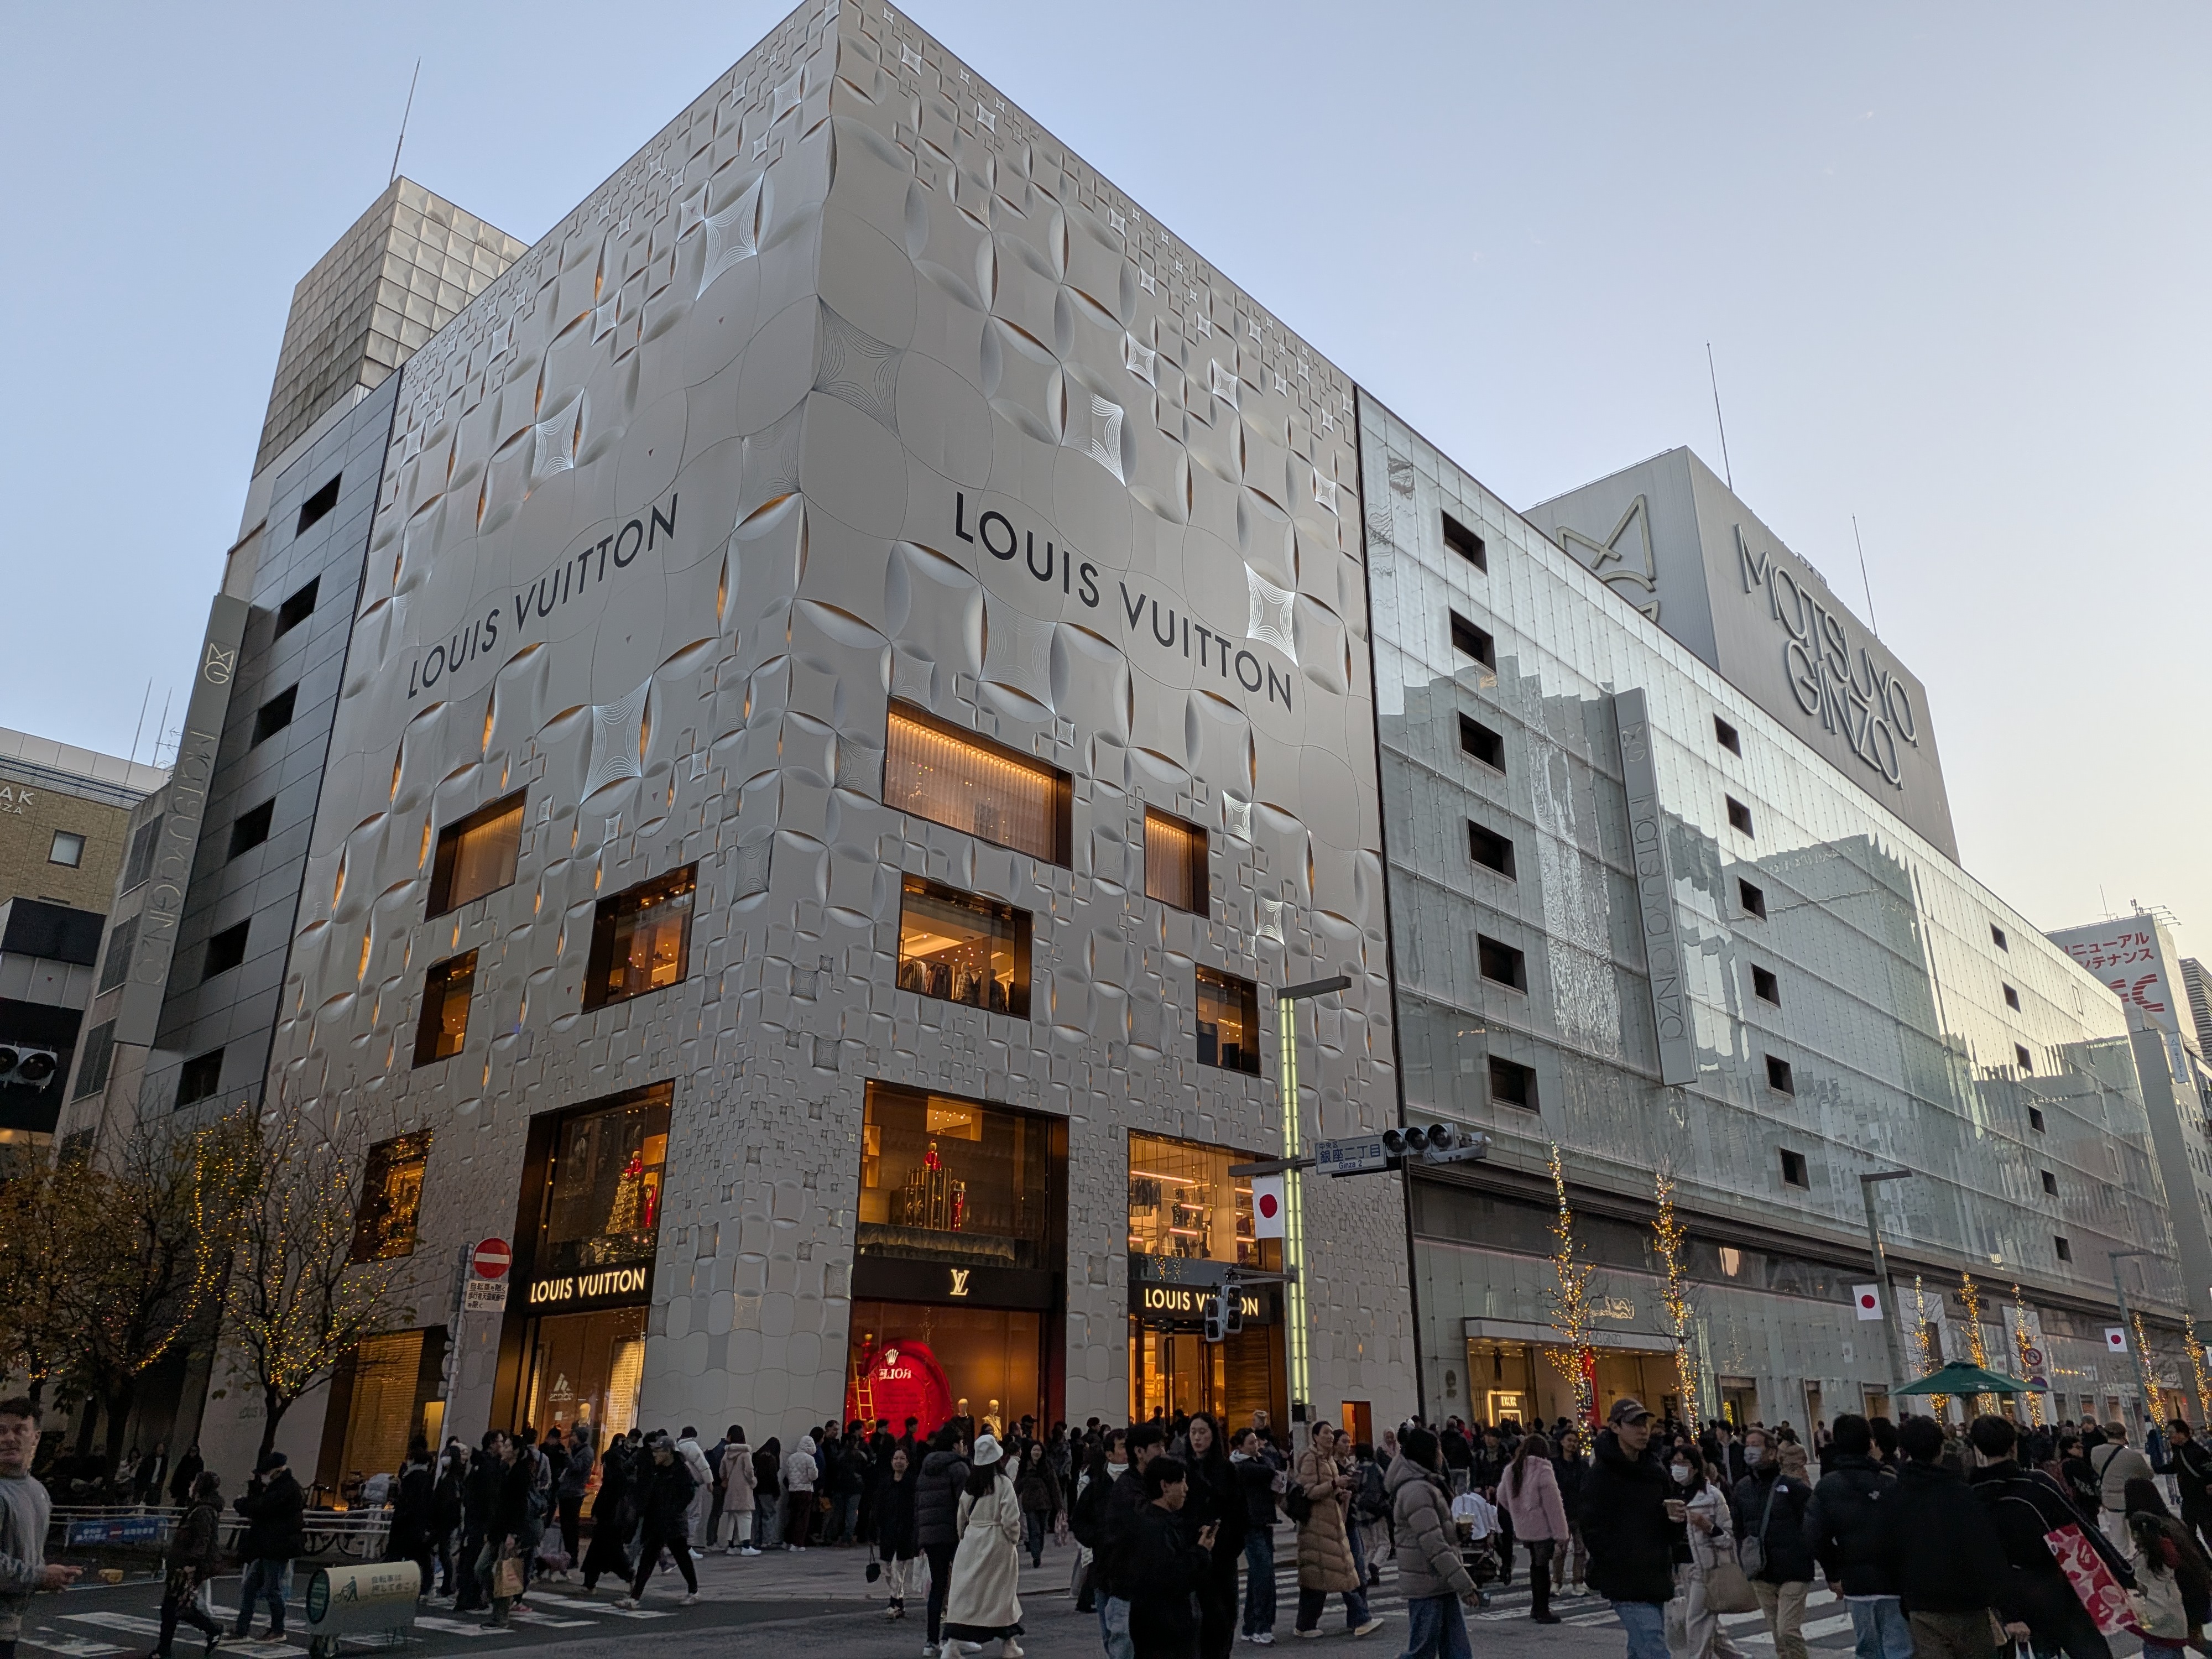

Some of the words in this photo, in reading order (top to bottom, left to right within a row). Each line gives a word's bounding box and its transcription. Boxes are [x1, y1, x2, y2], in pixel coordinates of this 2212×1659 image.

[408, 609, 500, 700] LOUIS
[516, 493, 679, 634] VUITTON
[956, 492, 1099, 608] LOUIS
[1119, 581, 1292, 714] VUITTON
[0, 802, 22, 815] ZA
[1319, 1141, 1338, 1150] 中央区
[1320, 1144, 1380, 1164] 銀座二丁目
[1338, 1161, 1356, 1170] Ginza
[1358, 1159, 1363, 1167] 2
[530, 1277, 573, 1303] LOUIS
[578, 1267, 645, 1298] VUITTON
[1145, 1288, 1191, 1311] LOUIS
[1501, 1396, 1518, 1407] DIOR
